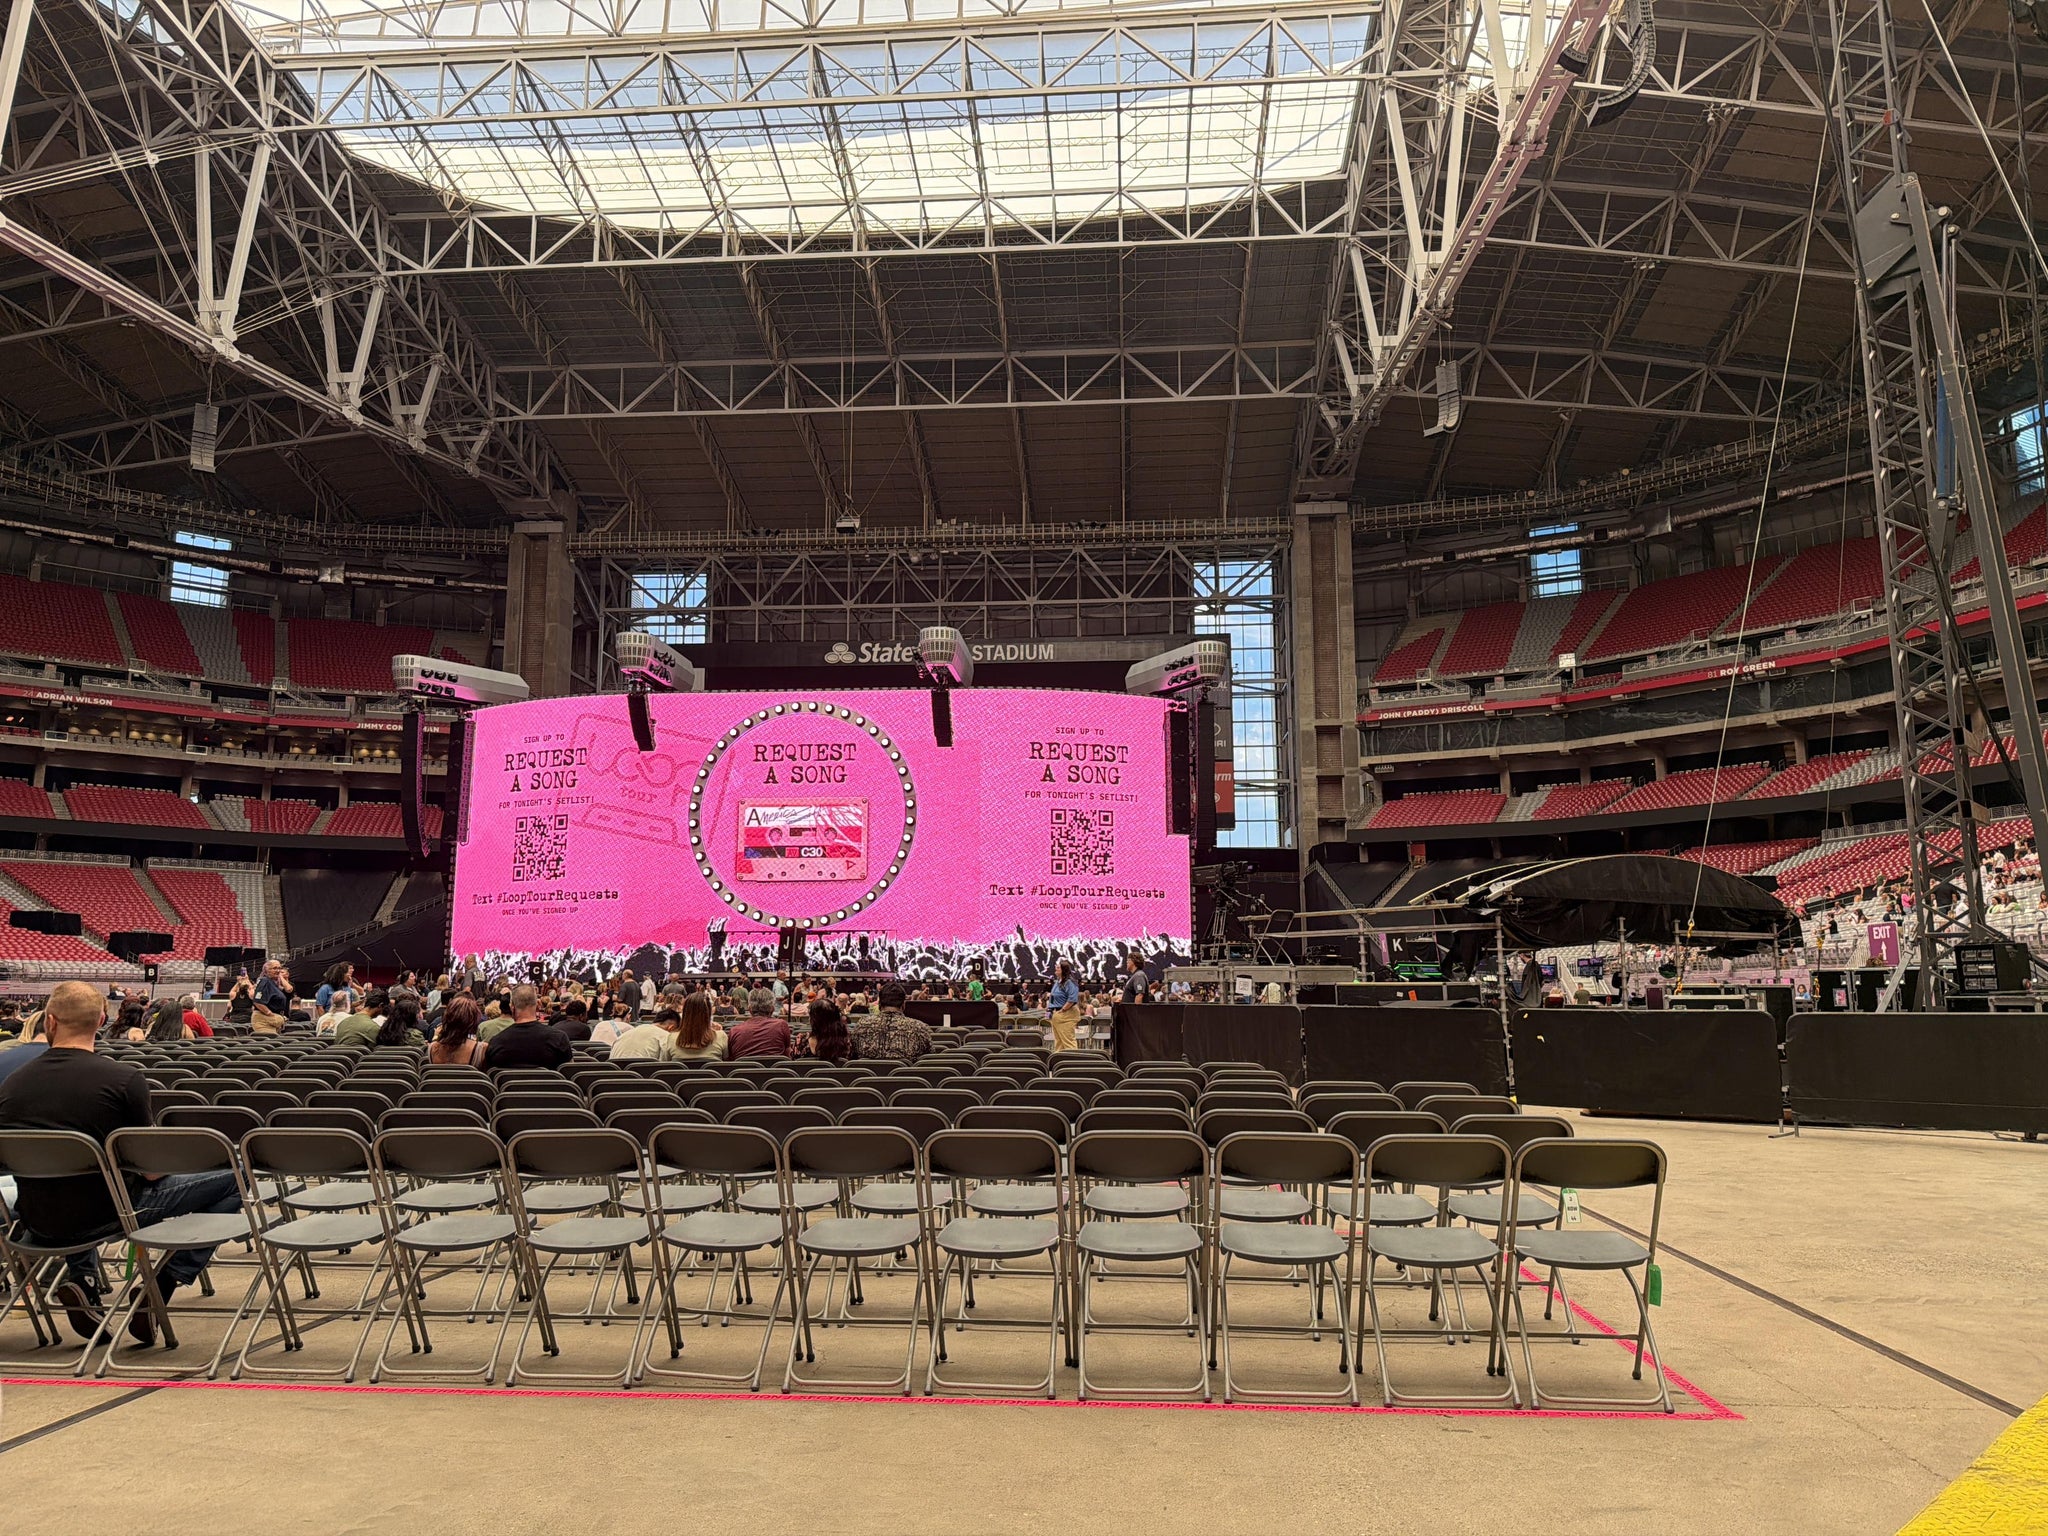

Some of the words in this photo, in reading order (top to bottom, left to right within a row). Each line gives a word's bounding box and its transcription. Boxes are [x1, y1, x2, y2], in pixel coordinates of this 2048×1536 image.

[858, 642, 914, 663] State
[972, 644, 1054, 661] STADIUM
[1720, 667, 1740, 677] ROY
[1742, 660, 1776, 672] GREEN
[36, 692, 73, 702] ADRIAN
[76, 696, 113, 706] WILSON
[1378, 712, 1401, 720] JOHN
[1403, 708, 1439, 718] (PADDY)
[1442, 704, 1484, 714] DRISCOLL
[1056, 727, 1076, 735] SIGN
[504, 748, 588, 771] REQUEST
[753, 743, 857, 762] REQUEST
[1029, 742, 1128, 764] REQUEST
[510, 775, 522, 792] A
[530, 770, 578, 790] SONG
[764, 766, 779, 784] A
[791, 766, 848, 784] SONG
[1040, 764, 1056, 783] A
[1068, 765, 1121, 785] SONG
[514, 799, 552, 808] TONIGHT'S
[556, 796, 594, 805] SETLIST!
[1025, 791, 1041, 799] FOR
[1047, 791, 1095, 800] TONIGHT'S
[1100, 794, 1138, 802] SETLIST!
[801, 847, 823, 857] C30
[472, 894, 493, 905] Text
[497, 889, 619, 905] #LoopTourRequests
[990, 884, 1024, 896] Text
[1030, 884, 1166, 900] #LoopTourRequests
[1062, 902, 1088, 910] YOU'VE
[1873, 926, 1891, 940] EXIT
[784, 936, 790, 949] J
[798, 937, 803, 950] J
[1392, 938, 1403, 951] K
[148, 968, 155, 976] B
[533, 966, 540, 974] C
[975, 962, 981, 970] D
